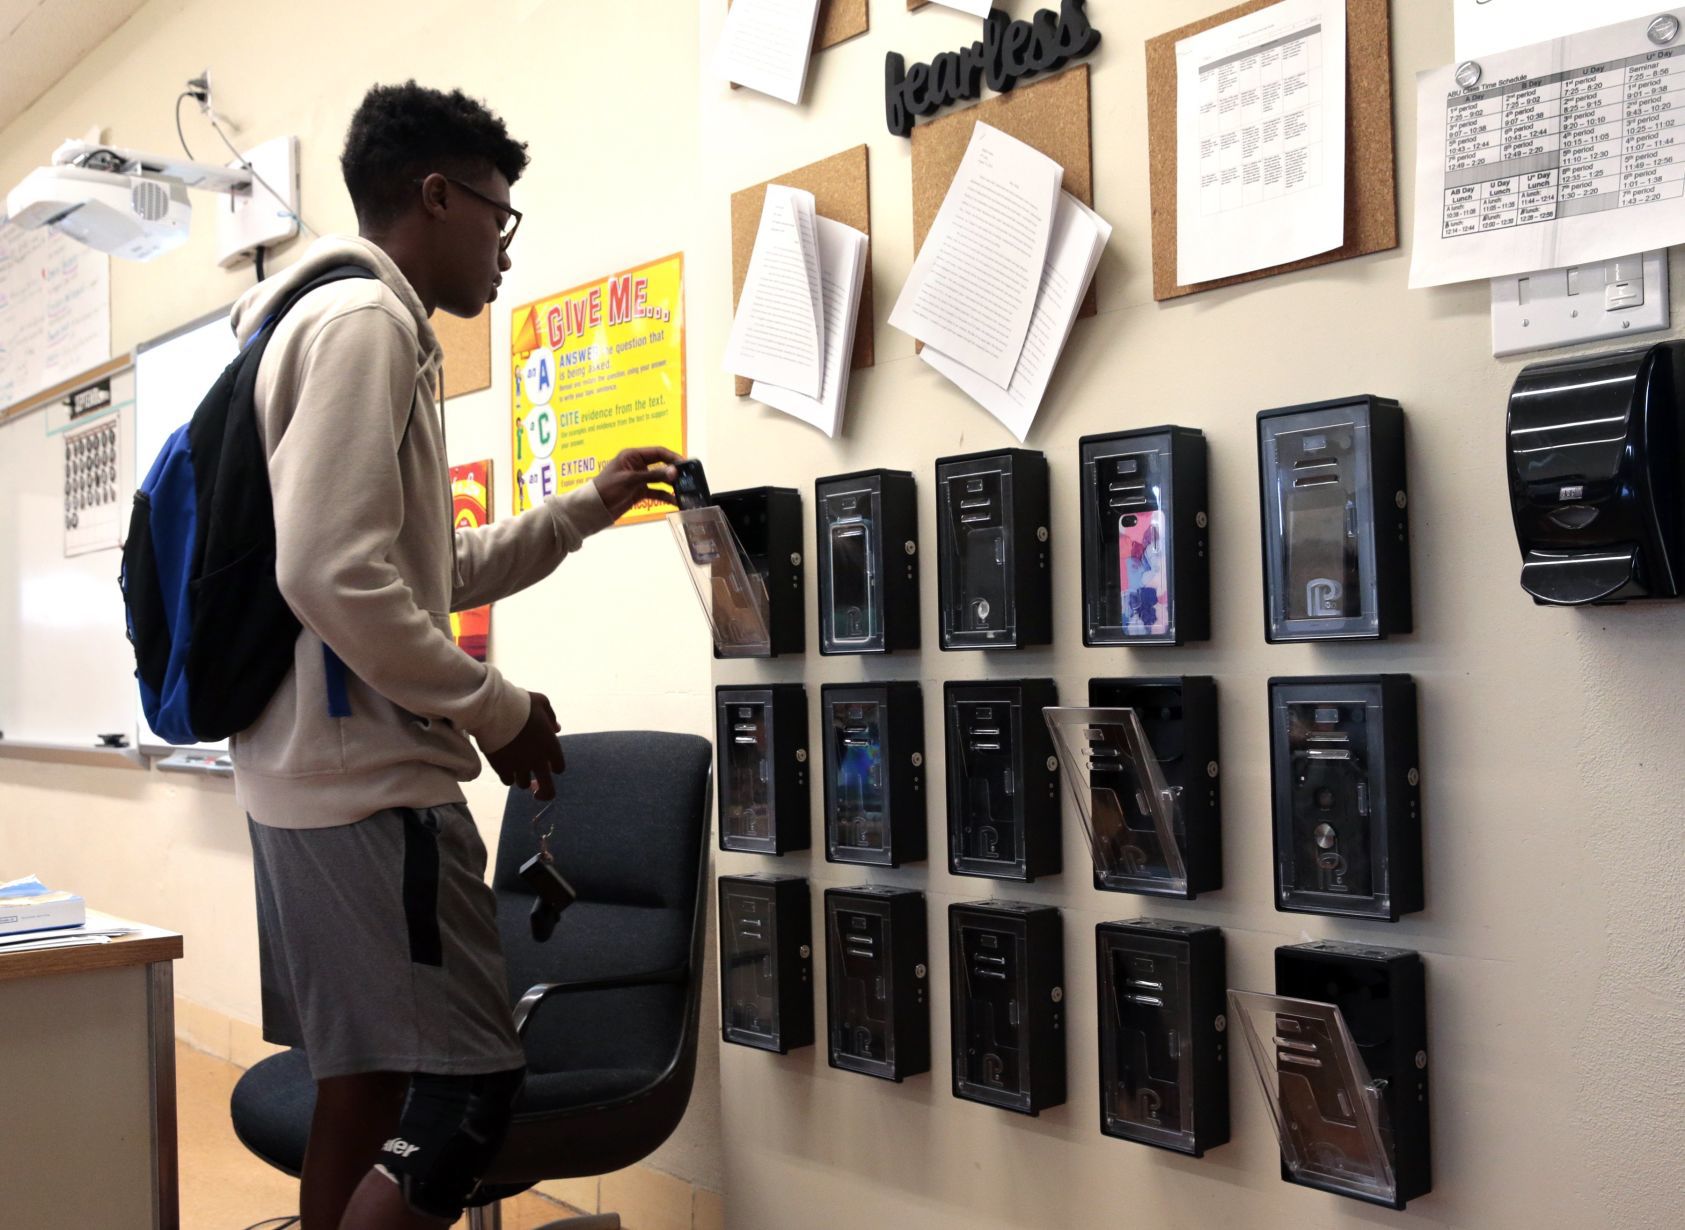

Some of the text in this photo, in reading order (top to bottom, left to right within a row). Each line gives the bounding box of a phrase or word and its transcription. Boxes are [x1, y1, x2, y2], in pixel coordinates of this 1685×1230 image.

[885, 0, 1101, 137] fearless
[1629, 62, 1659, 73] Seminar
[1499, 75, 1527, 85] Schedule
[1575, 76, 1596, 87] period
[1638, 79, 1661, 89] period
[1516, 89, 1536, 100] period
[1576, 92, 1597, 103] period
[1639, 96, 1661, 107] period
[1459, 103, 1478, 113] period
[1515, 107, 1534, 117] period
[1574, 111, 1595, 121] period
[1638, 115, 1659, 124] period
[1459, 120, 1477, 130] period
[1514, 124, 1534, 134] period
[1573, 128, 1594, 138] period
[1636, 133, 1658, 143] period
[1458, 136, 1476, 146] period
[1513, 141, 1533, 151] period
[1573, 146, 1594, 156] period
[1457, 152, 1476, 163] period
[1635, 151, 1658, 162] period
[1572, 164, 1593, 174] period
[1537, 172, 1550, 180] Day
[1634, 170, 1656, 179] period
[1528, 181, 1550, 189] Lunch
[1571, 181, 1592, 191] period
[1633, 187, 1655, 197] period
[547, 287, 601, 351] GIVE
[616, 335, 646, 354] question
[650, 330, 664, 344] that
[539, 358, 550, 391] A
[560, 371, 564, 380] is
[568, 367, 585, 379] being
[560, 395, 665, 427] CITE evidence from the text.
[538, 412, 550, 444] C
[562, 457, 595, 476] EXTEND
[542, 465, 551, 496] E
